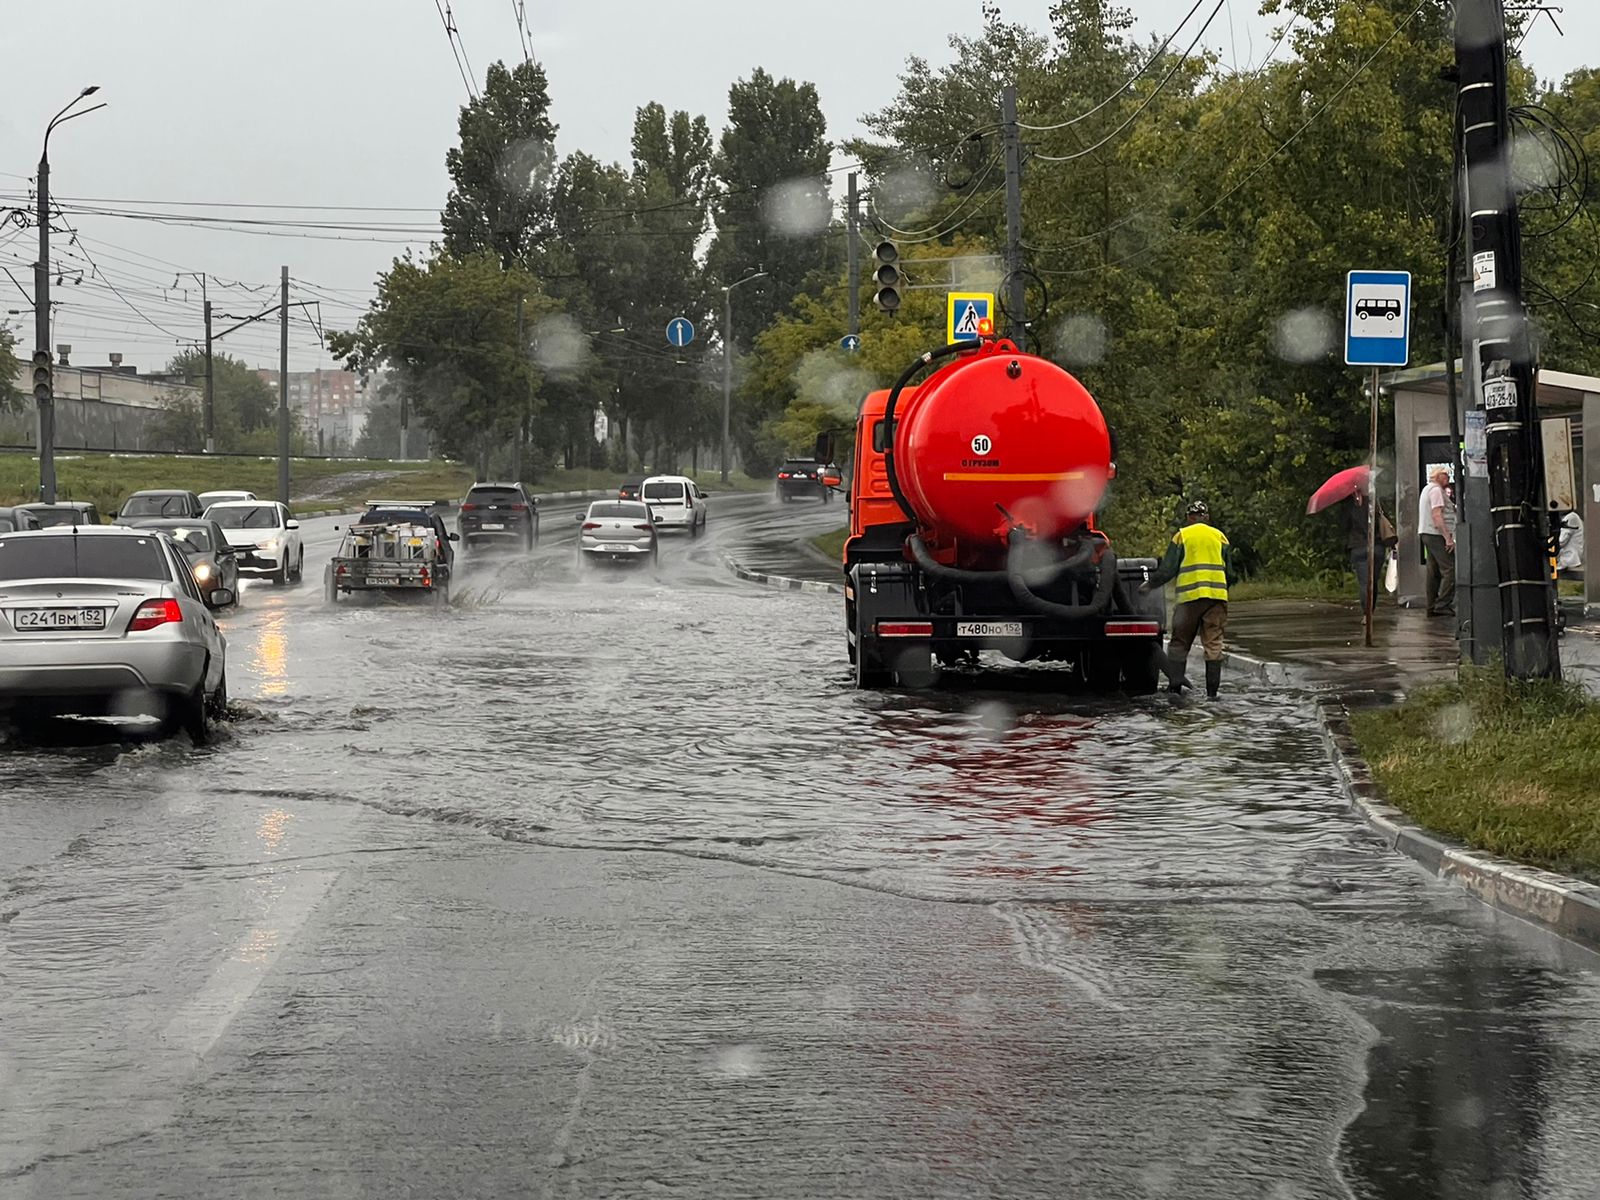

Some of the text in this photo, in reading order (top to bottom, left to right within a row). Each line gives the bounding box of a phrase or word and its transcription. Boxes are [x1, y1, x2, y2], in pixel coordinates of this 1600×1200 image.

[974, 438, 989, 452] 50
[20, 610, 101, 626] С241ВМ 152
[960, 623, 1020, 635] Т480НО 152
